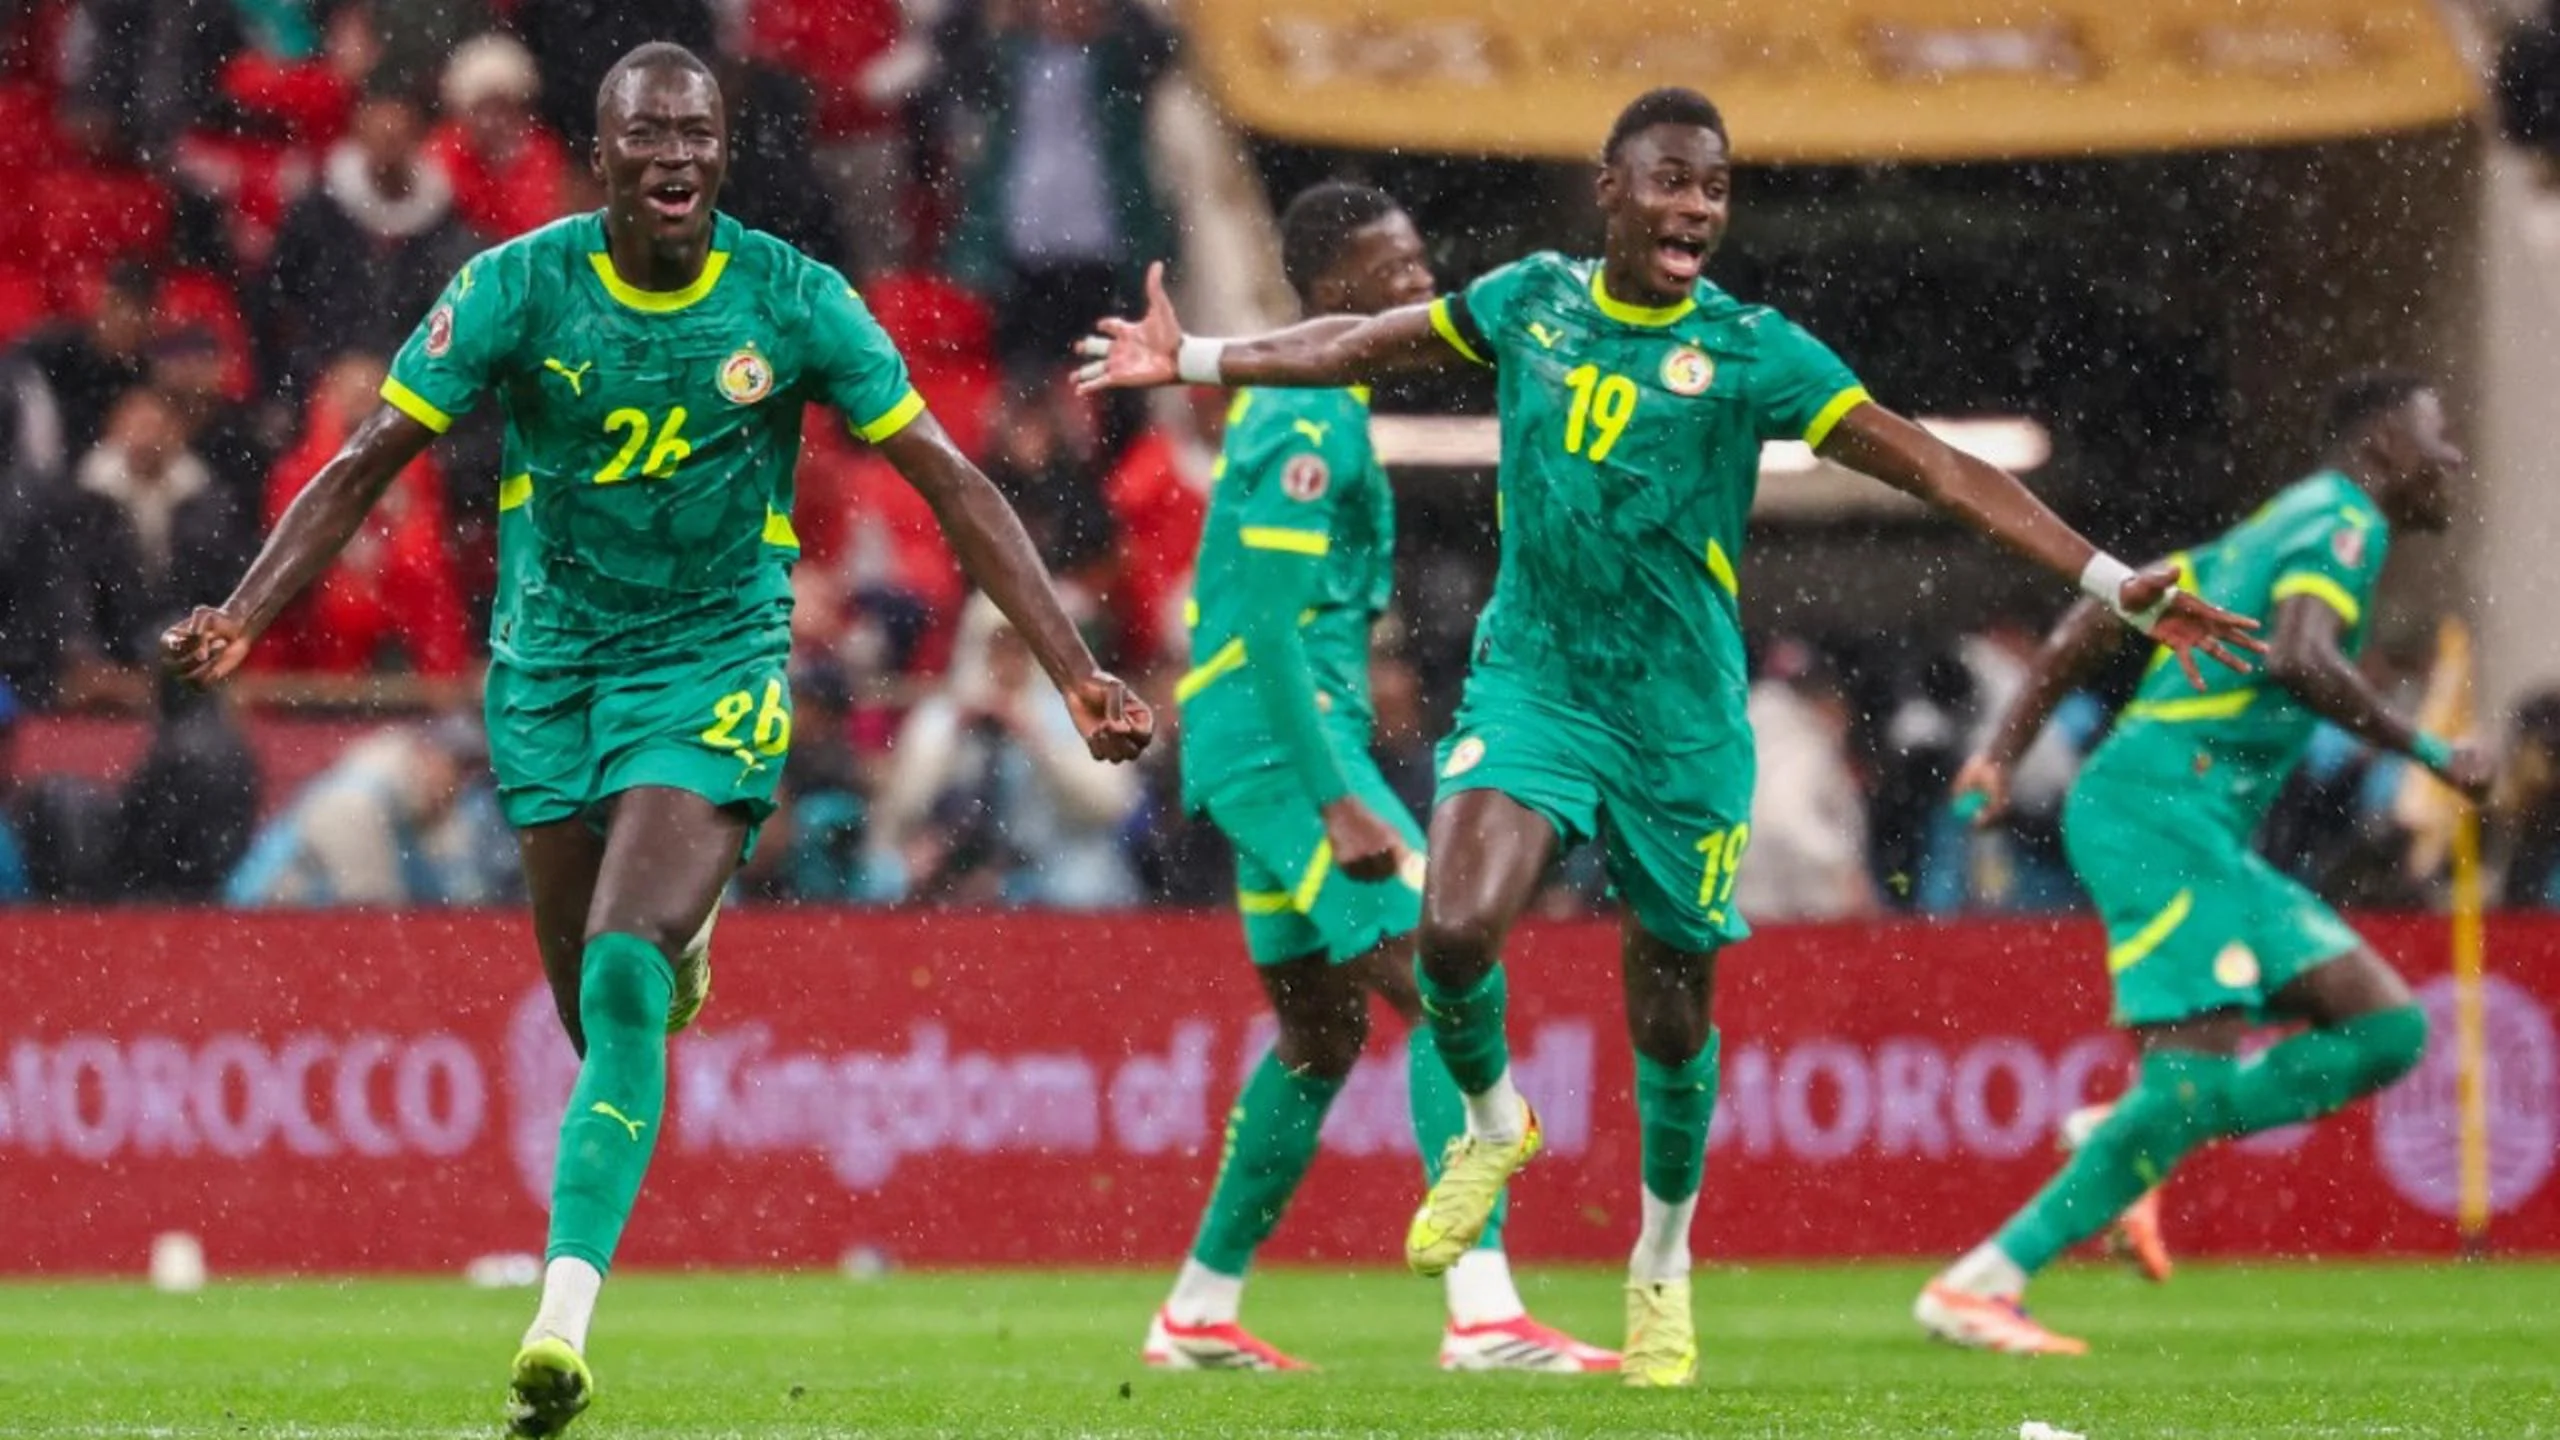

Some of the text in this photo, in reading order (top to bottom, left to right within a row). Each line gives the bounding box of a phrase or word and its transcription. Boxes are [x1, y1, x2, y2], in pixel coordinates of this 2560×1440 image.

[594, 405, 692, 484] 26
[1563, 364, 1638, 461] 19
[701, 677, 790, 756] 26
[1695, 822, 1749, 907] 19
